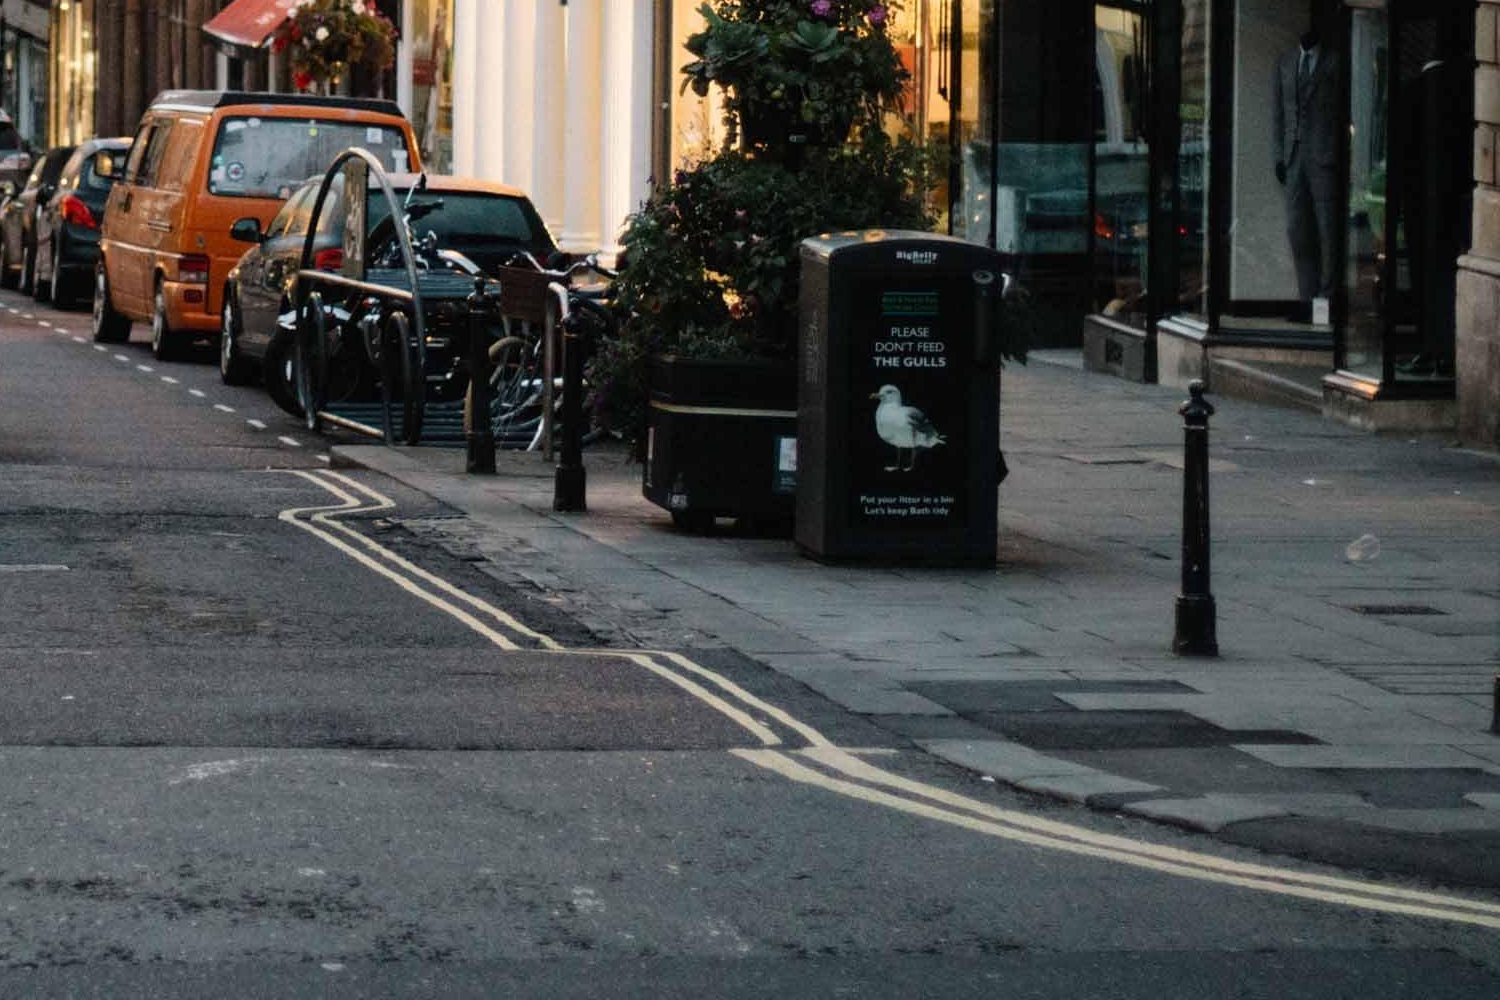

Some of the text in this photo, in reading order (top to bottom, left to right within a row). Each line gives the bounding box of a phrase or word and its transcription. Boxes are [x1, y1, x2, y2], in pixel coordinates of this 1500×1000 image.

[891, 327, 929, 337] PLEASE
[875, 342, 945, 352] DON'T FEED
[874, 357, 947, 367] THE GULLS
[860, 496, 875, 504] Put
[877, 497, 897, 505] your
